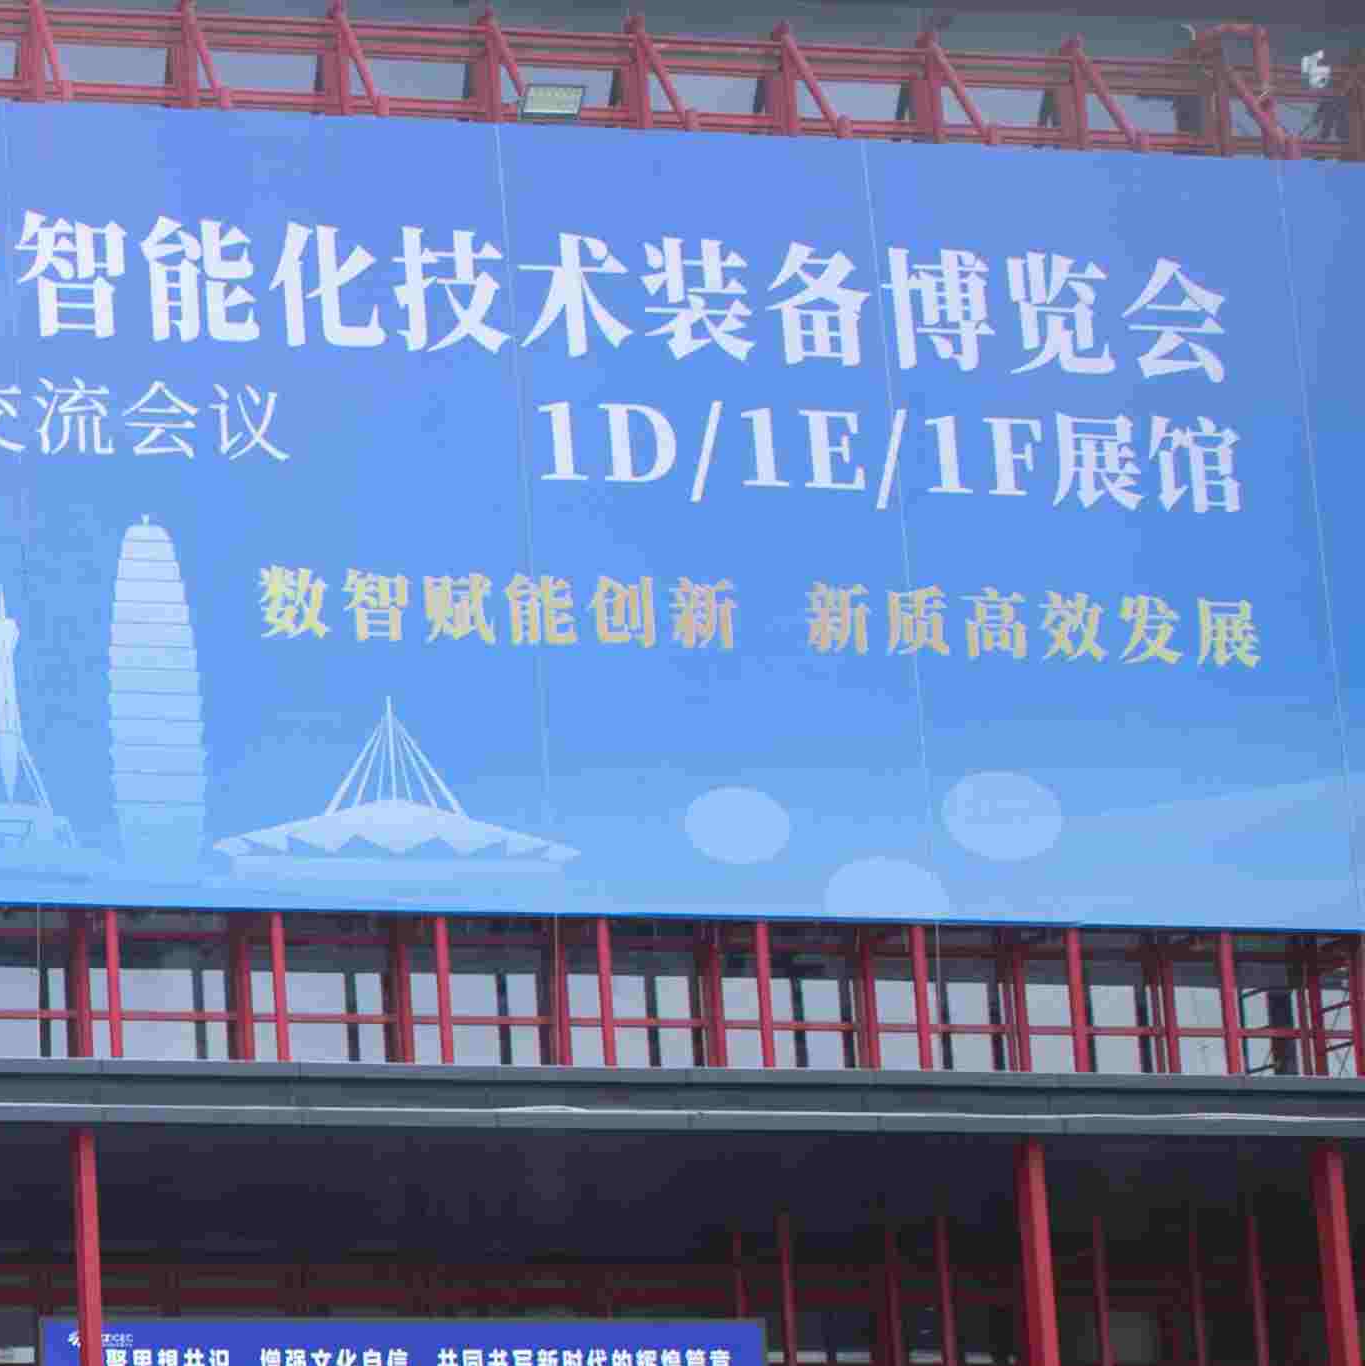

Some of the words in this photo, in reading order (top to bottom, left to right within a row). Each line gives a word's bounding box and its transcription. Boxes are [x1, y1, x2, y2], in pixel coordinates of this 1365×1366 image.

[537, 400, 1242, 514] 1D/1E/1F展馆
[257, 565, 737, 652] 数智赋能创新
[804, 580, 1262, 671] 新质高效发展
